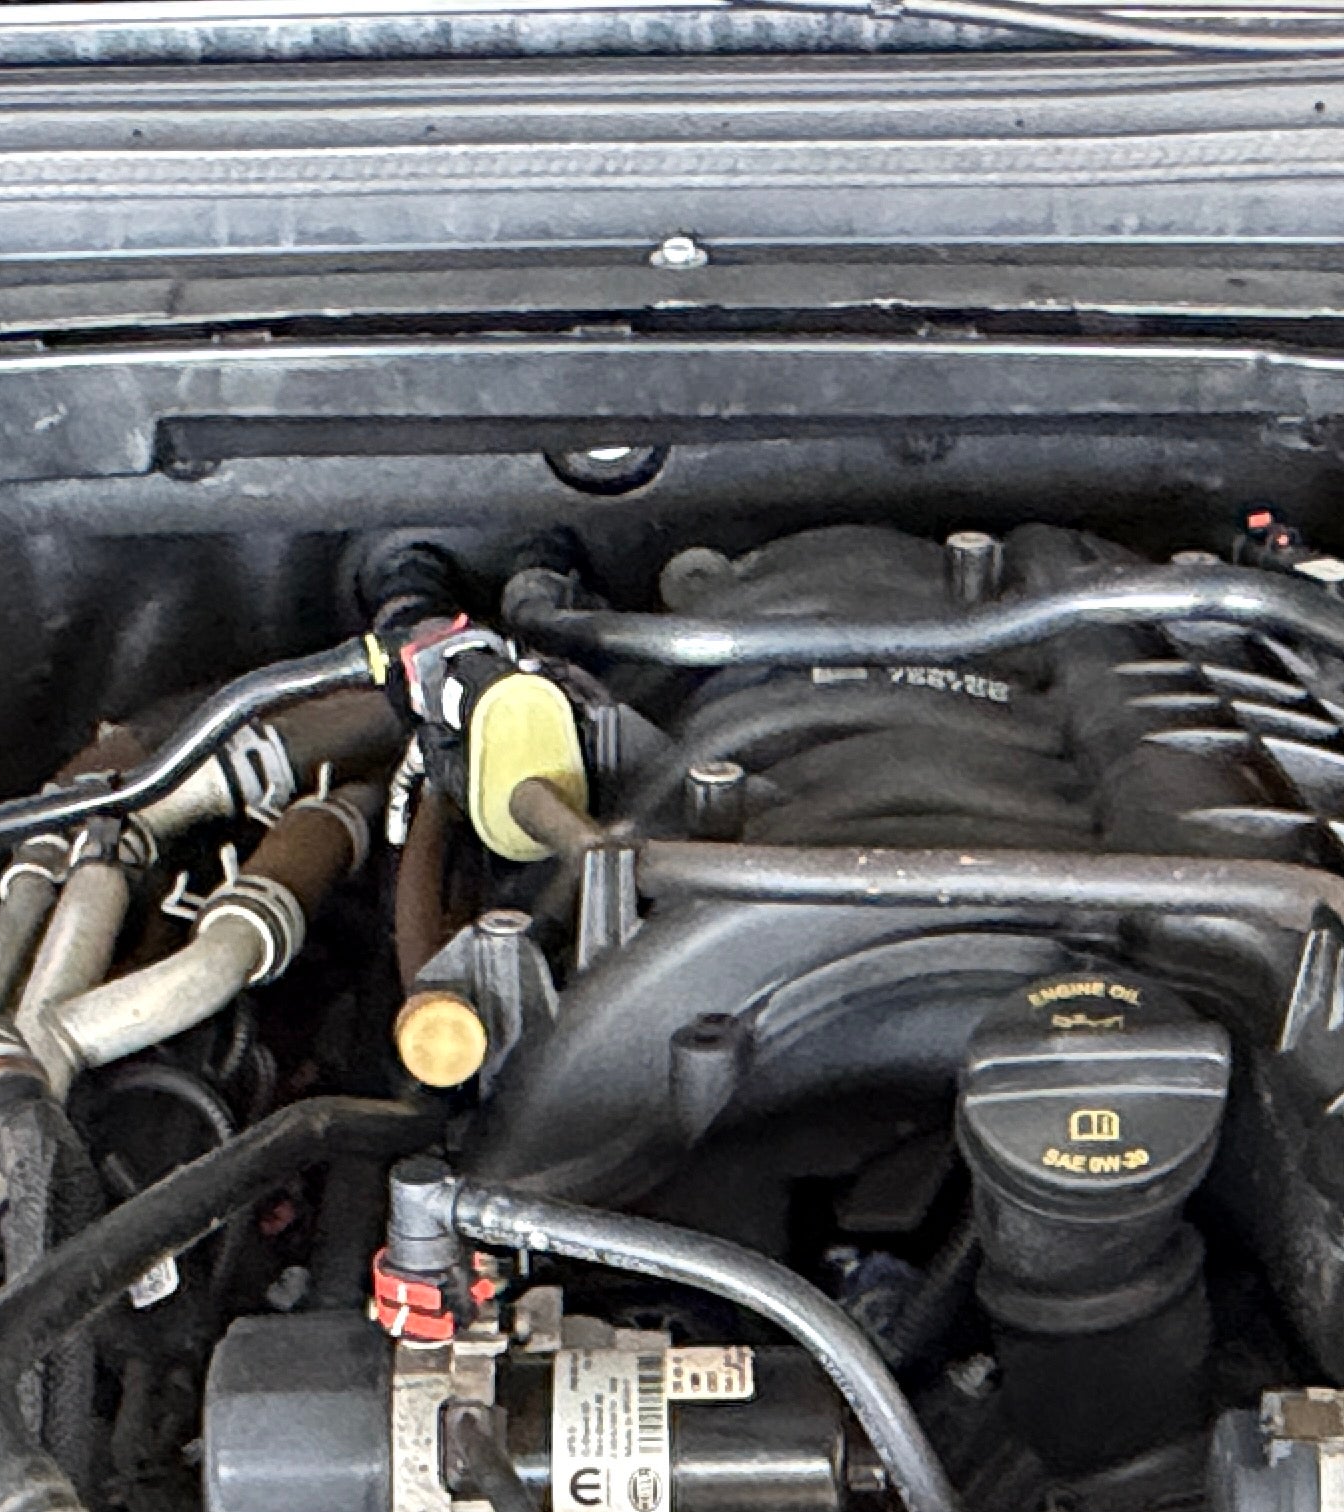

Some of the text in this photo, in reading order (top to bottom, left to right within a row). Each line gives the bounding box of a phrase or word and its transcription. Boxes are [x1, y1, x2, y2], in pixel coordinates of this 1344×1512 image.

[1028, 982, 1141, 1007] ENGINE OIL
[1043, 1148, 1086, 1173] SAE
